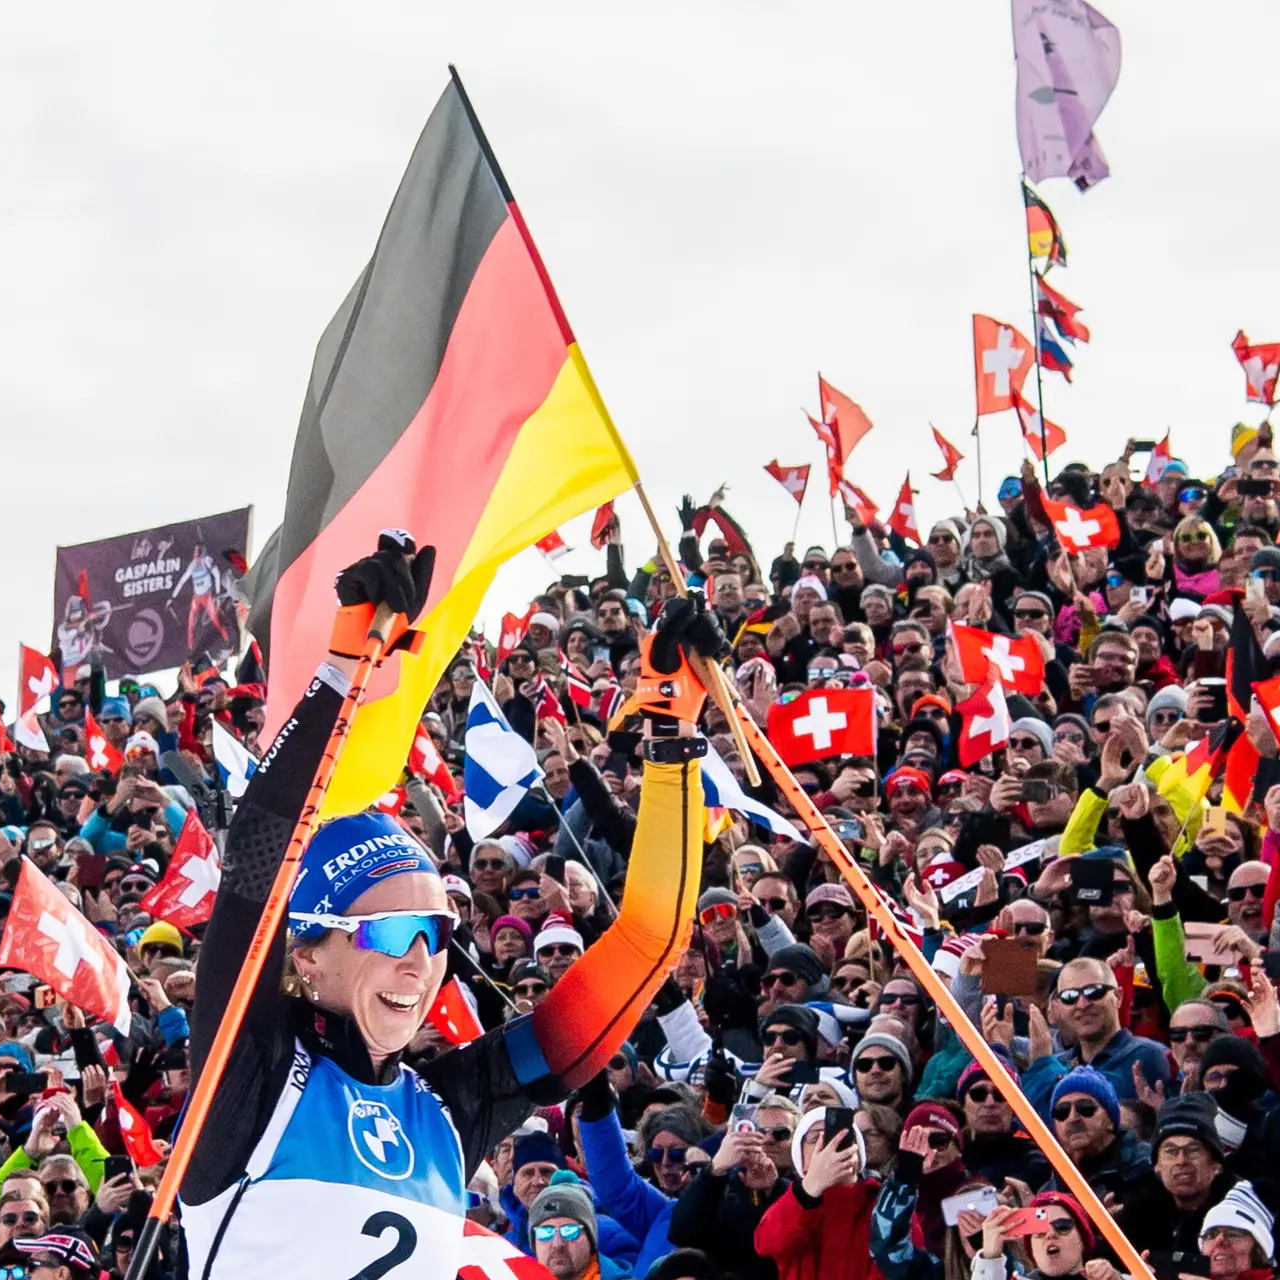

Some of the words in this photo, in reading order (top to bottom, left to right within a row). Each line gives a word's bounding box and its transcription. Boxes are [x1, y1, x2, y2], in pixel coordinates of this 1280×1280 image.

[115, 557, 181, 583] GASPARIN
[123, 575, 173, 598] SISTERS
[322, 833, 420, 881] ERDING
